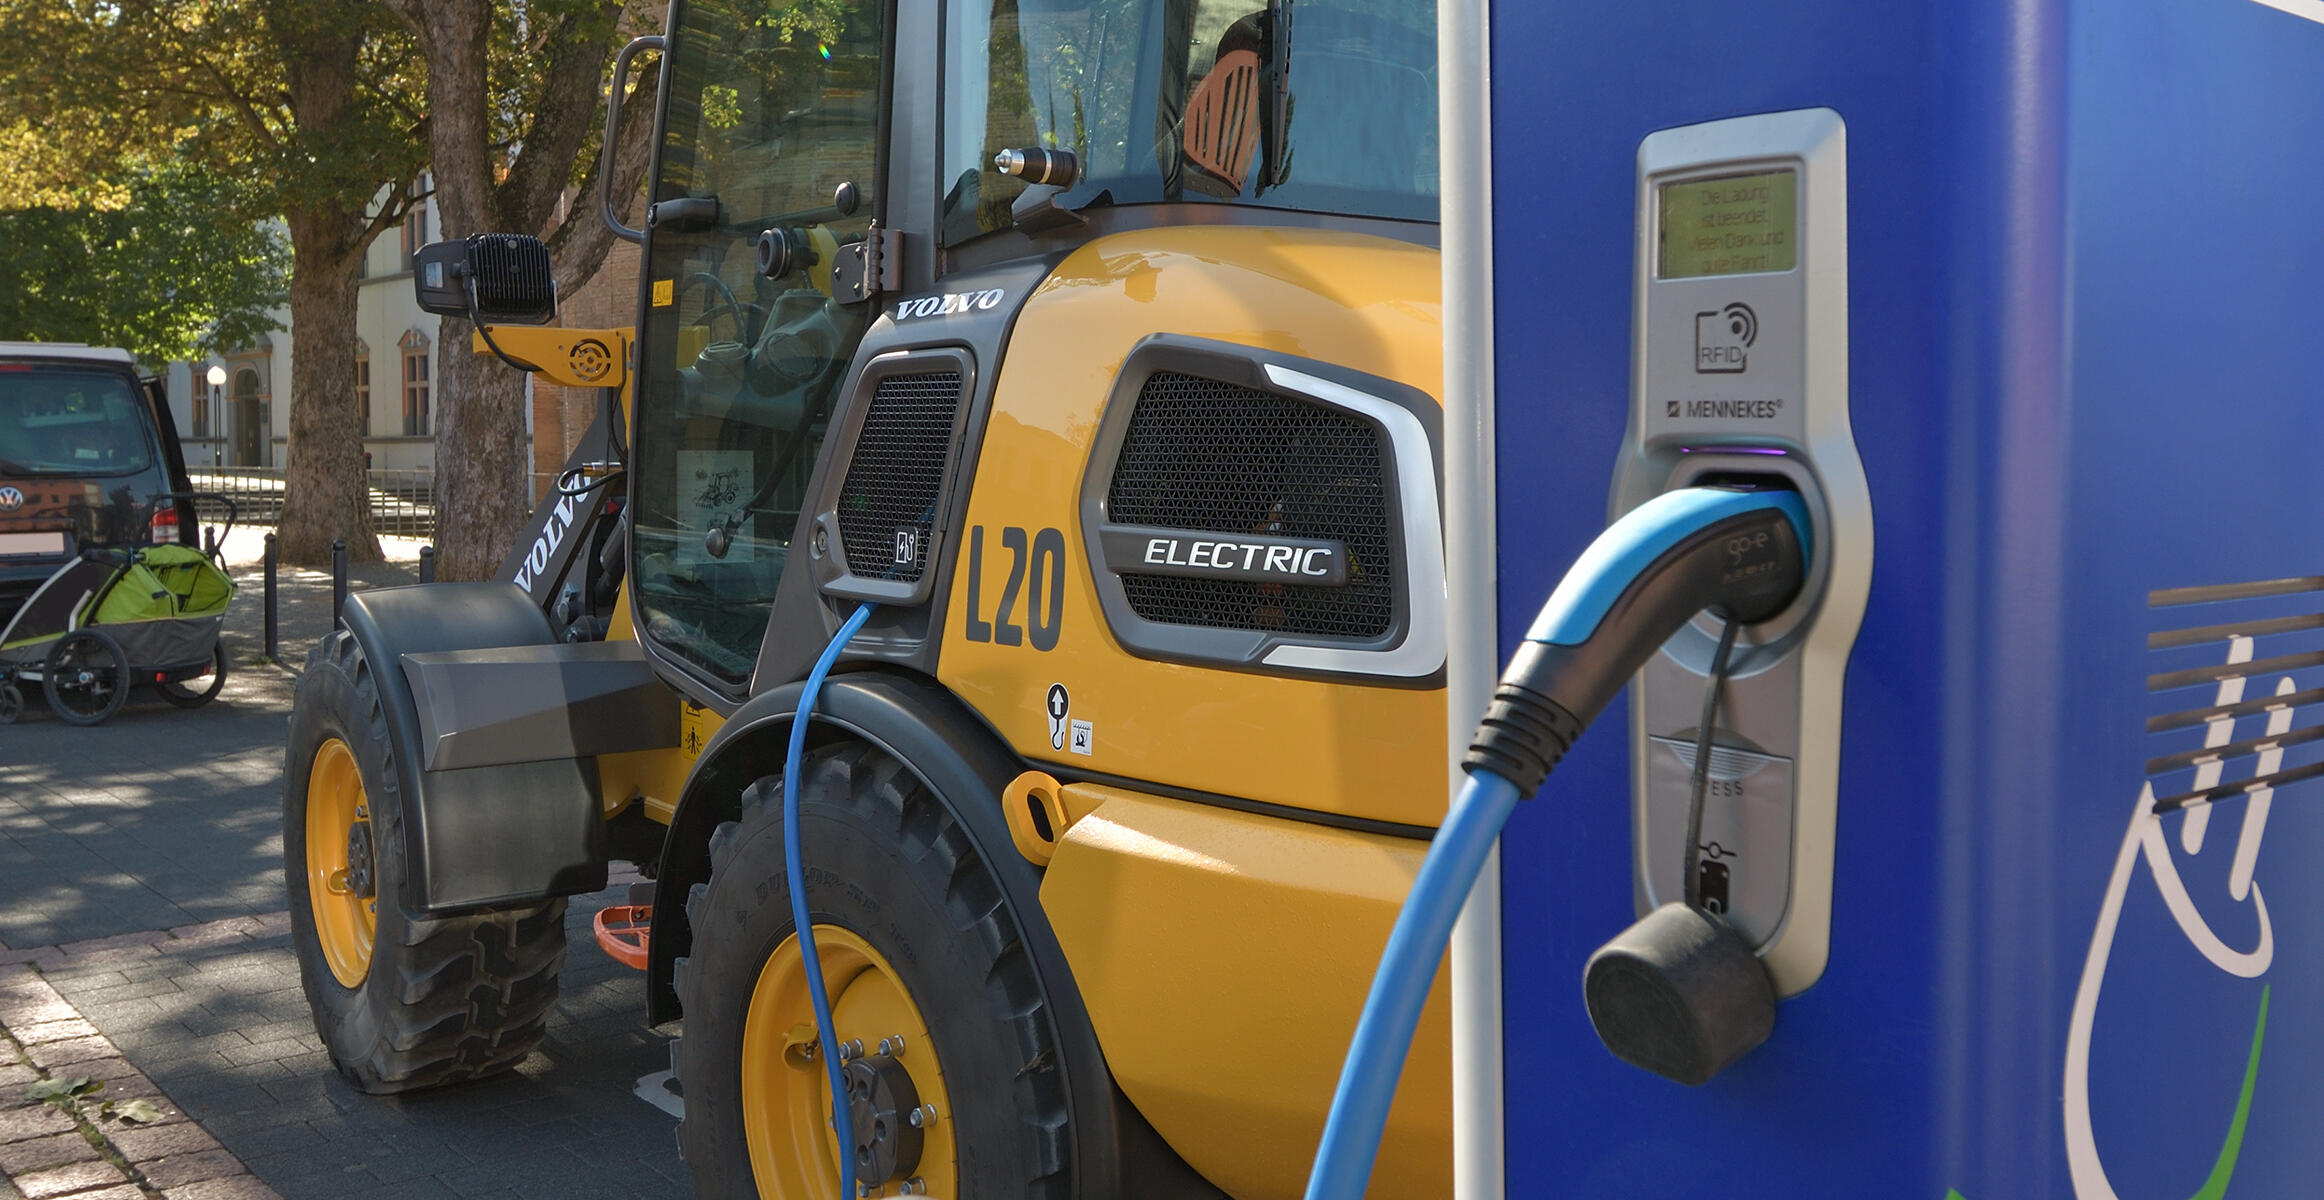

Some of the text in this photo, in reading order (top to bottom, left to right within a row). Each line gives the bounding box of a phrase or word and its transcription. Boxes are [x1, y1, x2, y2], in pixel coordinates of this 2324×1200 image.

[1701, 186, 1769, 206] Die Ladung
[896, 288, 1005, 320] VOLVO
[1701, 346, 1743, 363] RFID
[513, 472, 591, 593] VOLVO
[1144, 538, 1332, 576] ELECTRIC
[966, 525, 1066, 652] L20
